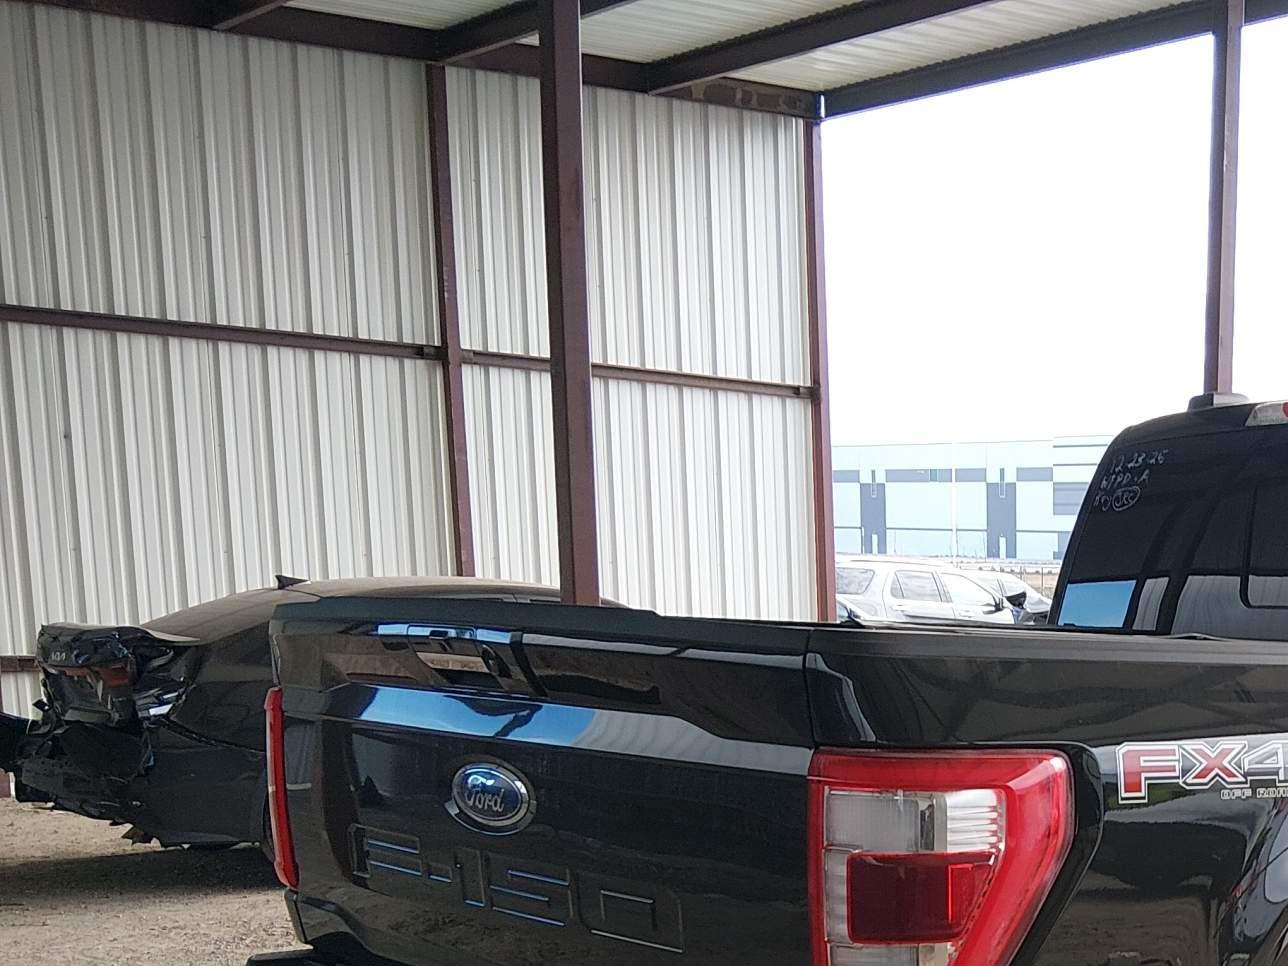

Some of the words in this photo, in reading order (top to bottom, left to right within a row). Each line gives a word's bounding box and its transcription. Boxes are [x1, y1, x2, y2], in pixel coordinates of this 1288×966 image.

[465, 774, 505, 812] Ford
[1220, 787, 1252, 800] OFF
[348, 824, 687, 953] F-150
